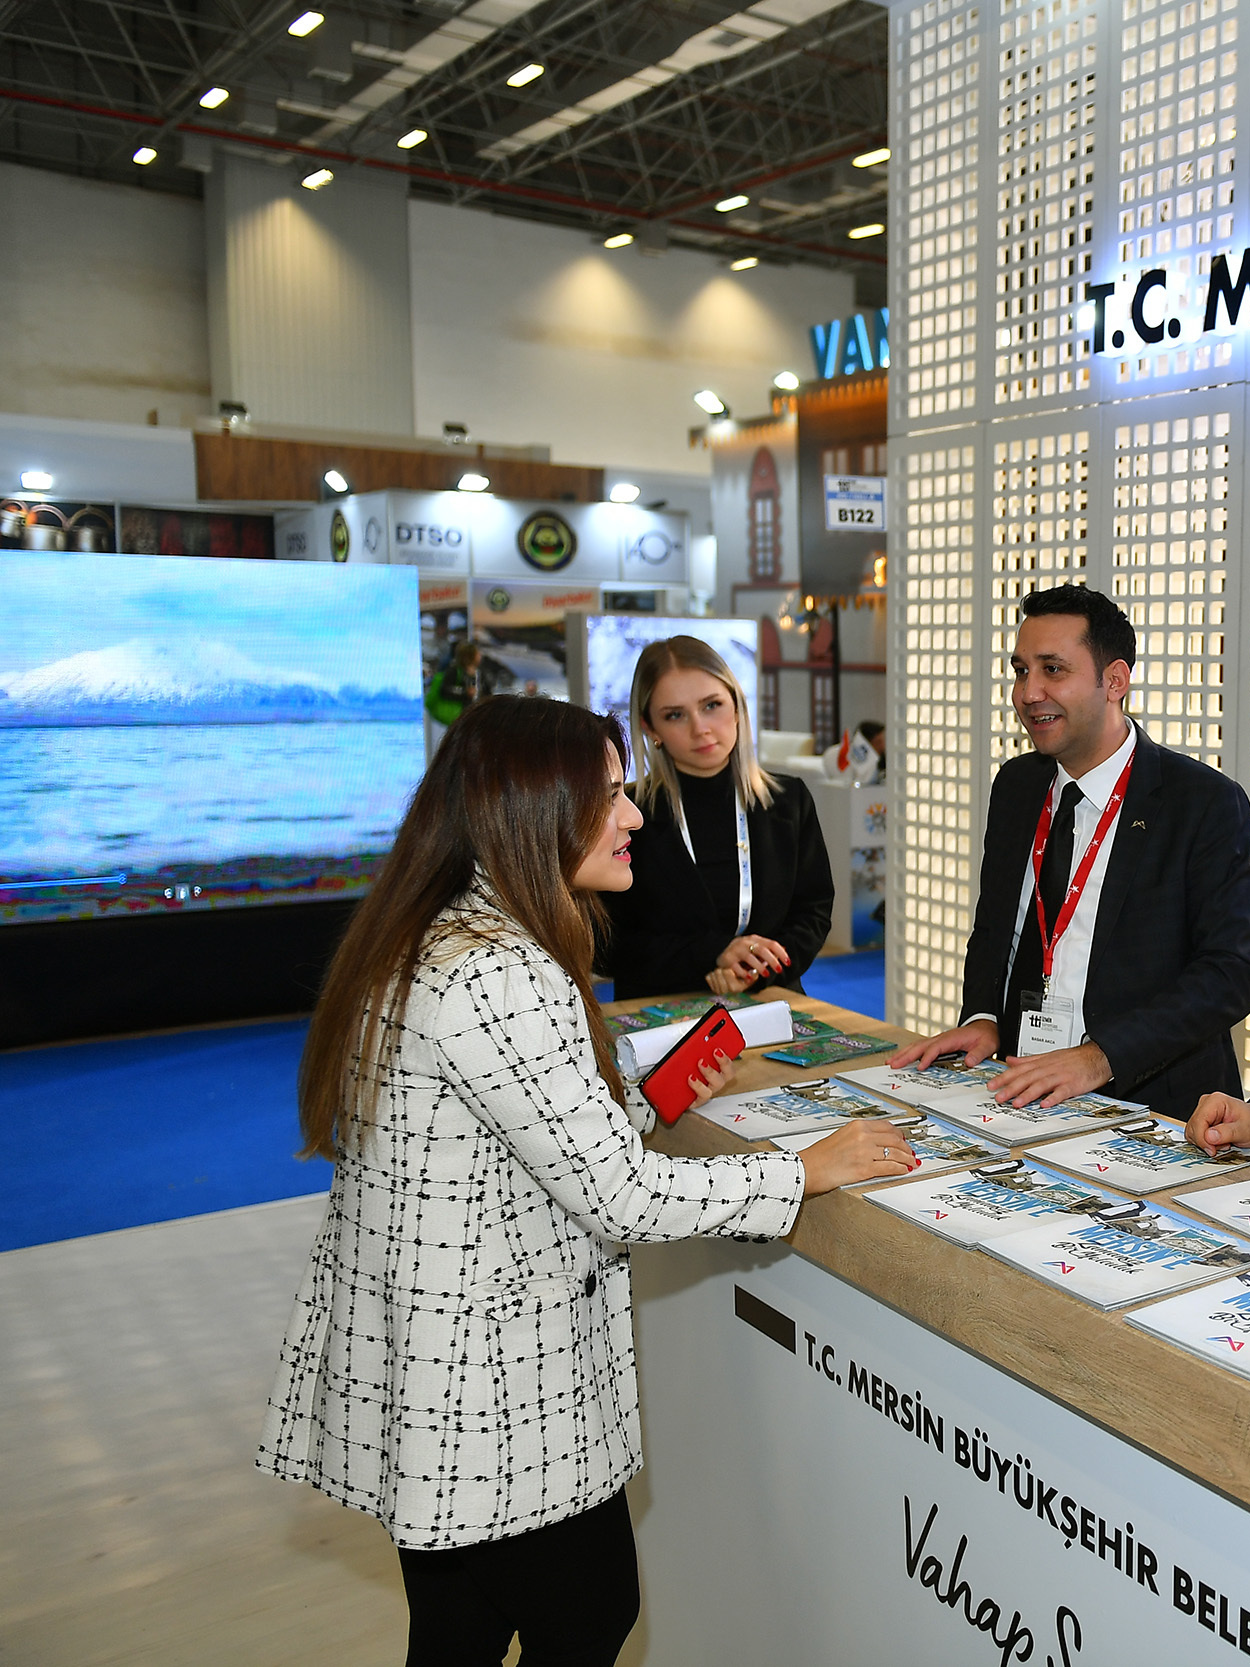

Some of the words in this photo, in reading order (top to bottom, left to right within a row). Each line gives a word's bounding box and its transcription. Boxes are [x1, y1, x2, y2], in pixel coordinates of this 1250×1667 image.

[1086, 270, 1182, 354] T.C.
[396, 523, 462, 547] DTSO
[838, 508, 875, 523] B122
[1028, 1014, 1042, 1028] tti
[804, 1331, 842, 1387] T.C.
[848, 1360, 944, 1455] MERSİN
[953, 1426, 1160, 1597] BÜYÜKŞEHİR
[903, 1494, 1035, 1667] Vahap
